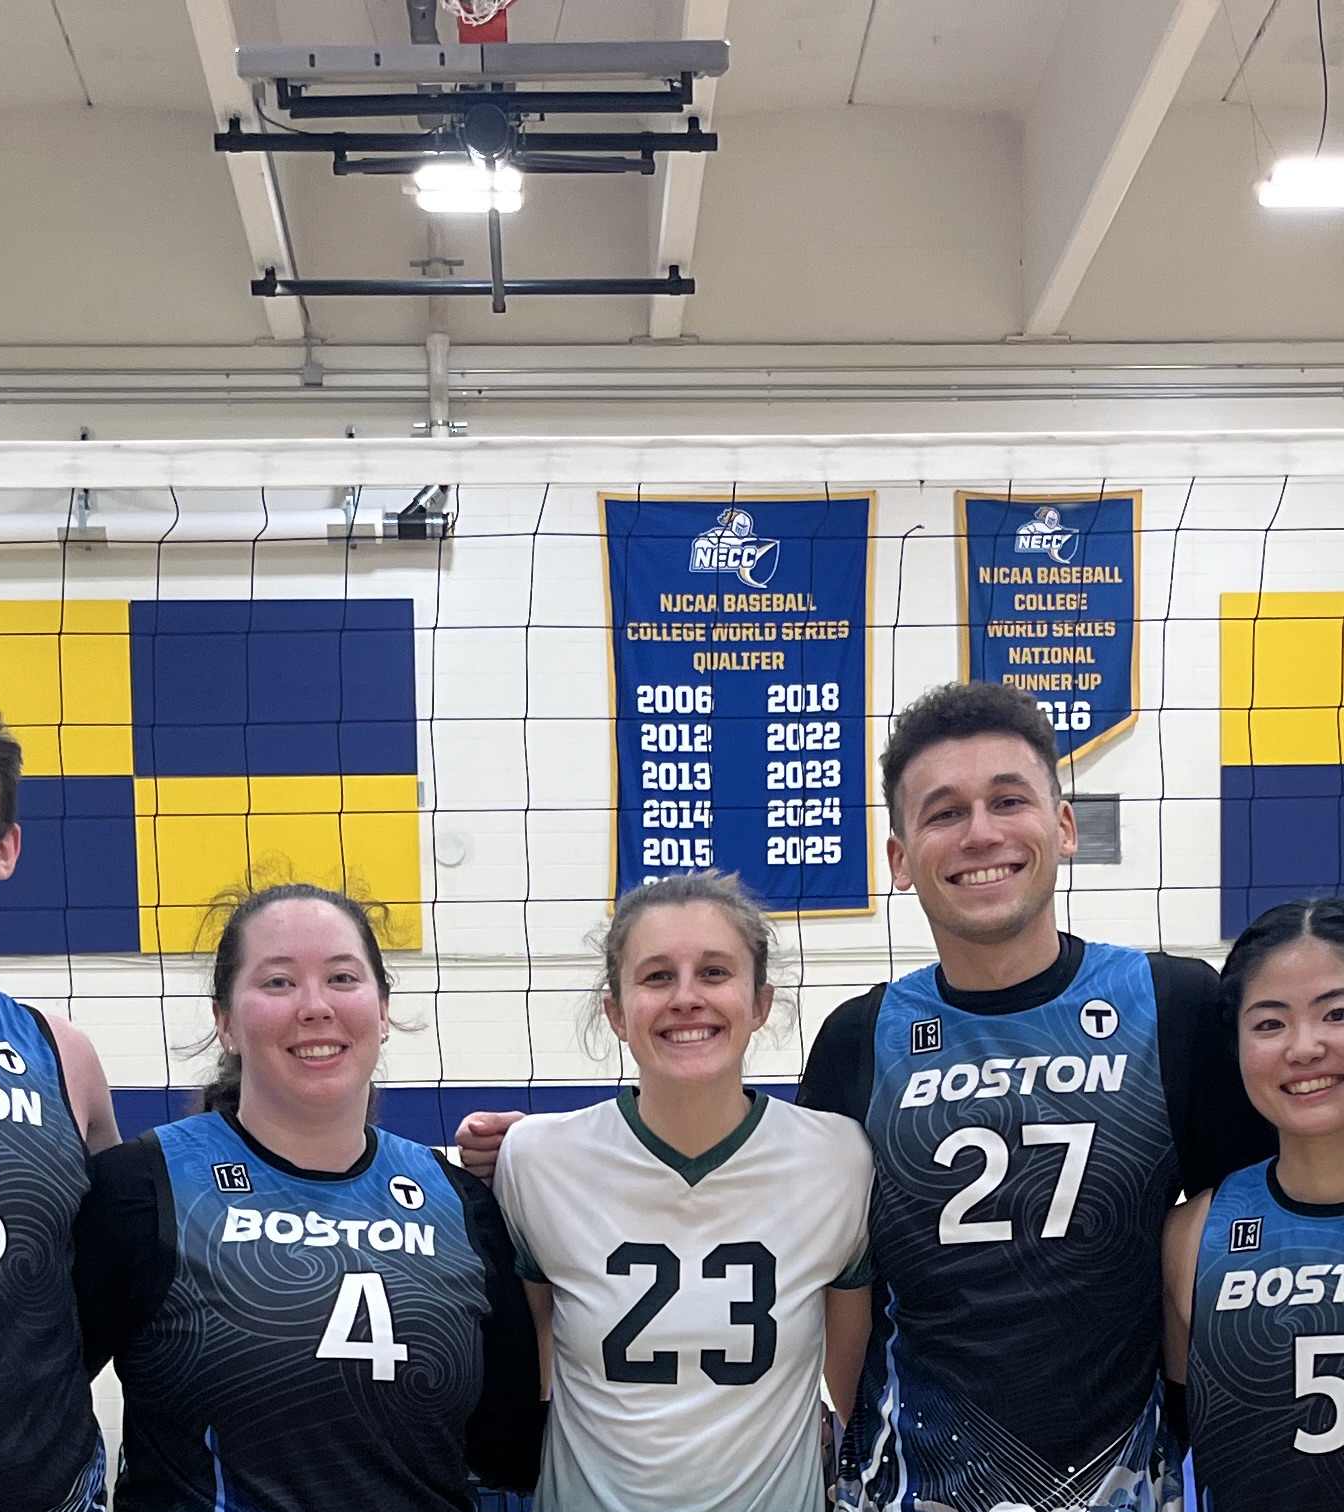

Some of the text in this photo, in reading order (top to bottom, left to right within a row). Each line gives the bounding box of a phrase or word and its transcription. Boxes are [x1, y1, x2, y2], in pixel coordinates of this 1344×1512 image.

[1018, 535, 1064, 549] NECC
[694, 547, 757, 570] NECC
[979, 567, 1123, 584] NJCAA BASEBALL
[660, 593, 817, 612] NJCAA BASEBALL
[1014, 593, 1088, 611] COLLEGE
[627, 621, 849, 642] COLLEGE WORLD SERIES
[987, 619, 1116, 638] WORLD SERIES
[693, 652, 785, 674] QUALIFER
[1009, 647, 1095, 664] NATIONAL
[637, 685, 713, 714] 2006
[767, 683, 840, 713] 2018
[641, 724, 713, 752] 2012
[767, 722, 841, 752] 2022
[642, 762, 712, 791] 2013
[767, 760, 841, 790] 2023
[643, 799, 713, 829] 2014
[767, 797, 841, 827] 2024
[643, 838, 713, 867] 2015
[767, 836, 842, 865] 2025
[1085, 1009, 1112, 1033] T
[900, 1054, 1127, 1109] BOSTON
[393, 1183, 417, 1205] T
[933, 1122, 1096, 1245] 27
[222, 1206, 435, 1256] BOSTON
[316, 1273, 408, 1381] 4
[602, 1241, 777, 1385] 23
